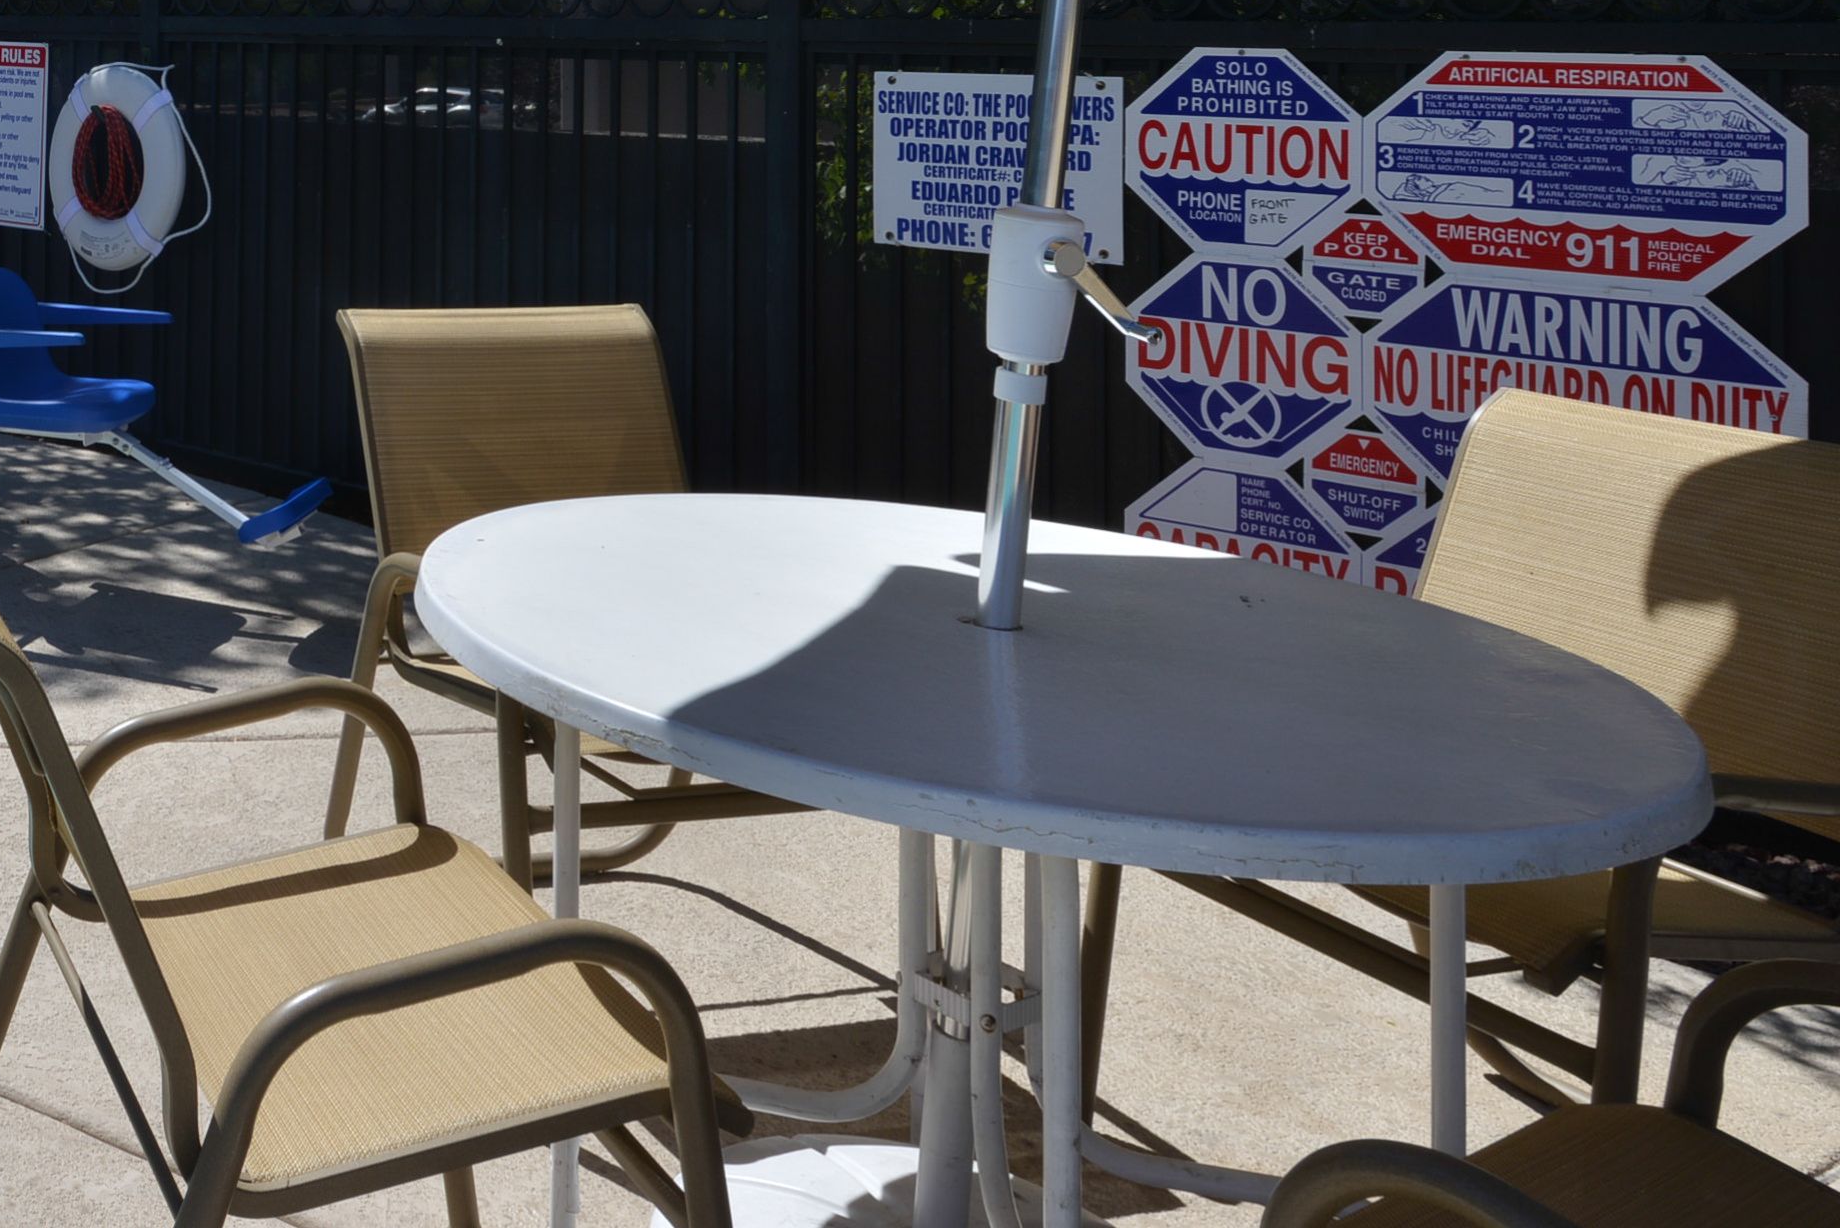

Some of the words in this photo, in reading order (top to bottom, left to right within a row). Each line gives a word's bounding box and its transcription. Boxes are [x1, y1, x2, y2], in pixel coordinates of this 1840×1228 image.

[1, 48, 41, 65] RULES
[1215, 61, 1267, 76] SOLO
[1449, 67, 1550, 84] ARTIFICIAL
[1555, 69, 1689, 88] RESPIRATION
[1191, 78, 1271, 96] BATHING
[1276, 80, 1293, 96] IS
[878, 90, 939, 115] SERVICE
[944, 92, 969, 117] CO:
[973, 93, 1001, 117] THE
[1177, 96, 1308, 116] PROHIBITED
[1412, 92, 1423, 115] 1
[1528, 104, 1553, 112] PUSH
[890, 117, 989, 140] OPERATOR
[1518, 125, 1535, 149] 2
[1679, 131, 1704, 139] OPEN
[1707, 132, 1733, 140] YOUR
[1736, 133, 1770, 141] MOUTH
[897, 142, 970, 165] JORDAN
[1138, 119, 1349, 181] CAUTION
[1657, 138, 1689, 146] MOUTH
[1746, 142, 1784, 150] REPEAT
[1379, 145, 1394, 168] 3
[923, 165, 1011, 183] CERTIFICATE#:
[911, 180, 1001, 206] EDUARDO
[1177, 190, 1242, 211] PHONE
[1518, 180, 1535, 204] 4
[1609, 187, 1632, 195] CALL
[1635, 188, 1652, 196] THE
[1251, 198, 1296, 210] FRONT
[1189, 210, 1242, 223] LOCATION
[1249, 214, 1288, 224] GATE
[896, 218, 975, 247] PHONE:
[1343, 232, 1389, 246] KEEP
[1437, 223, 1562, 247] EMERGENCY
[1324, 242, 1409, 261] POOL
[1471, 244, 1531, 259] DIAL
[1565, 233, 1639, 272] 911
[1648, 240, 1716, 254] MEDICAL
[1648, 251, 1702, 264] POLICE
[1648, 261, 1681, 273] FIRE
[1327, 272, 1401, 290] GATE
[1202, 265, 1287, 326] NO
[1341, 286, 1387, 303] CLOSED
[1451, 287, 1703, 374] WARNING
[1138, 316, 1349, 396] DIVING
[1374, 345, 1419, 407] NO
[1623, 374, 1675, 417] ON
[1691, 382, 1789, 434] DUTY
[1330, 452, 1400, 478] EMERGENCY
[1241, 477, 1266, 488] NAME
[1241, 486, 1271, 499] PHONE
[1328, 488, 1401, 511] SHUT-OFF
[1241, 496, 1265, 508] CERT.
[1267, 500, 1283, 511] NO.
[1241, 509, 1290, 527] SERVICE
[1293, 516, 1314, 531] CO.
[1343, 504, 1385, 523] SWITCH
[1241, 521, 1317, 545] OPERATOR
